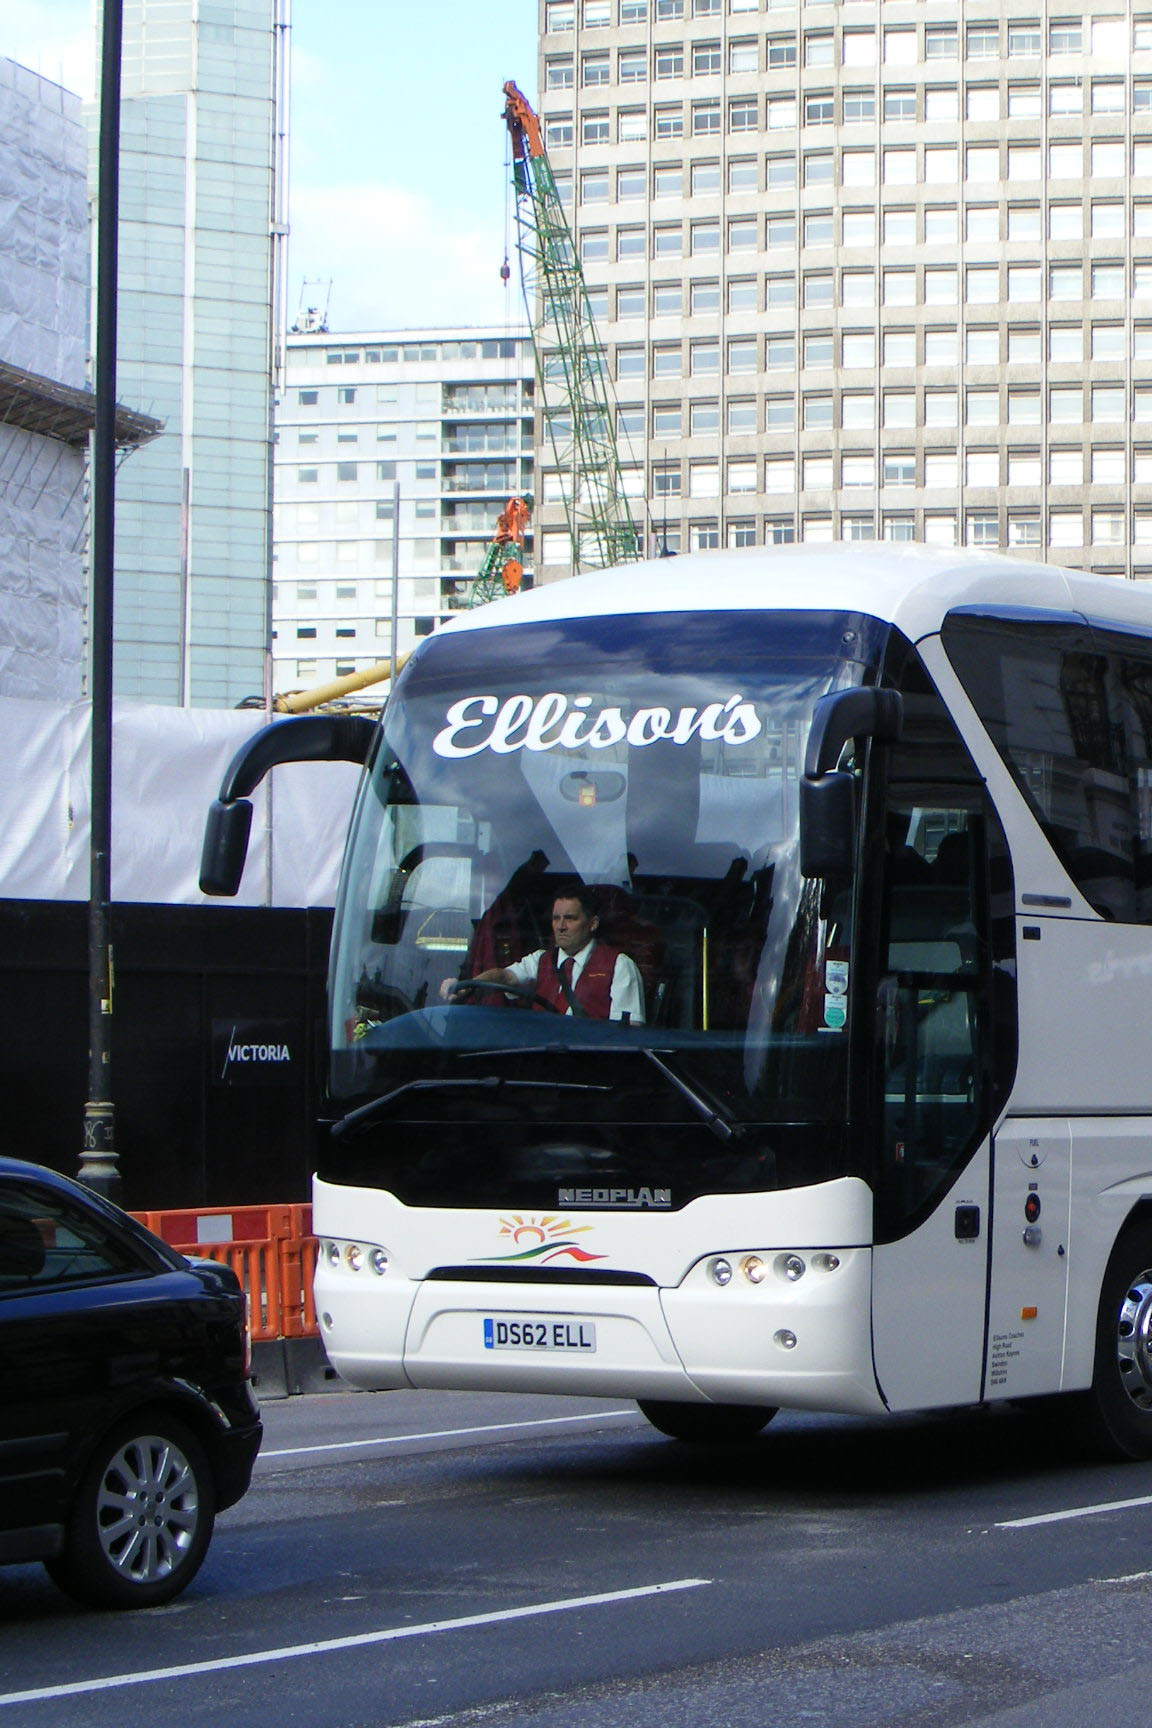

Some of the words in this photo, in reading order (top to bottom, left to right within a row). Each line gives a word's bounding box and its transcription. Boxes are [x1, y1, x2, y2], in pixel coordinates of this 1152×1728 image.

[433, 692, 762, 759] Ellison's
[228, 1044, 290, 1062] VICTORIA
[558, 1187, 672, 1206] NEOPLAN
[496, 1322, 547, 1346] DS62
[553, 1324, 592, 1347] ELL
